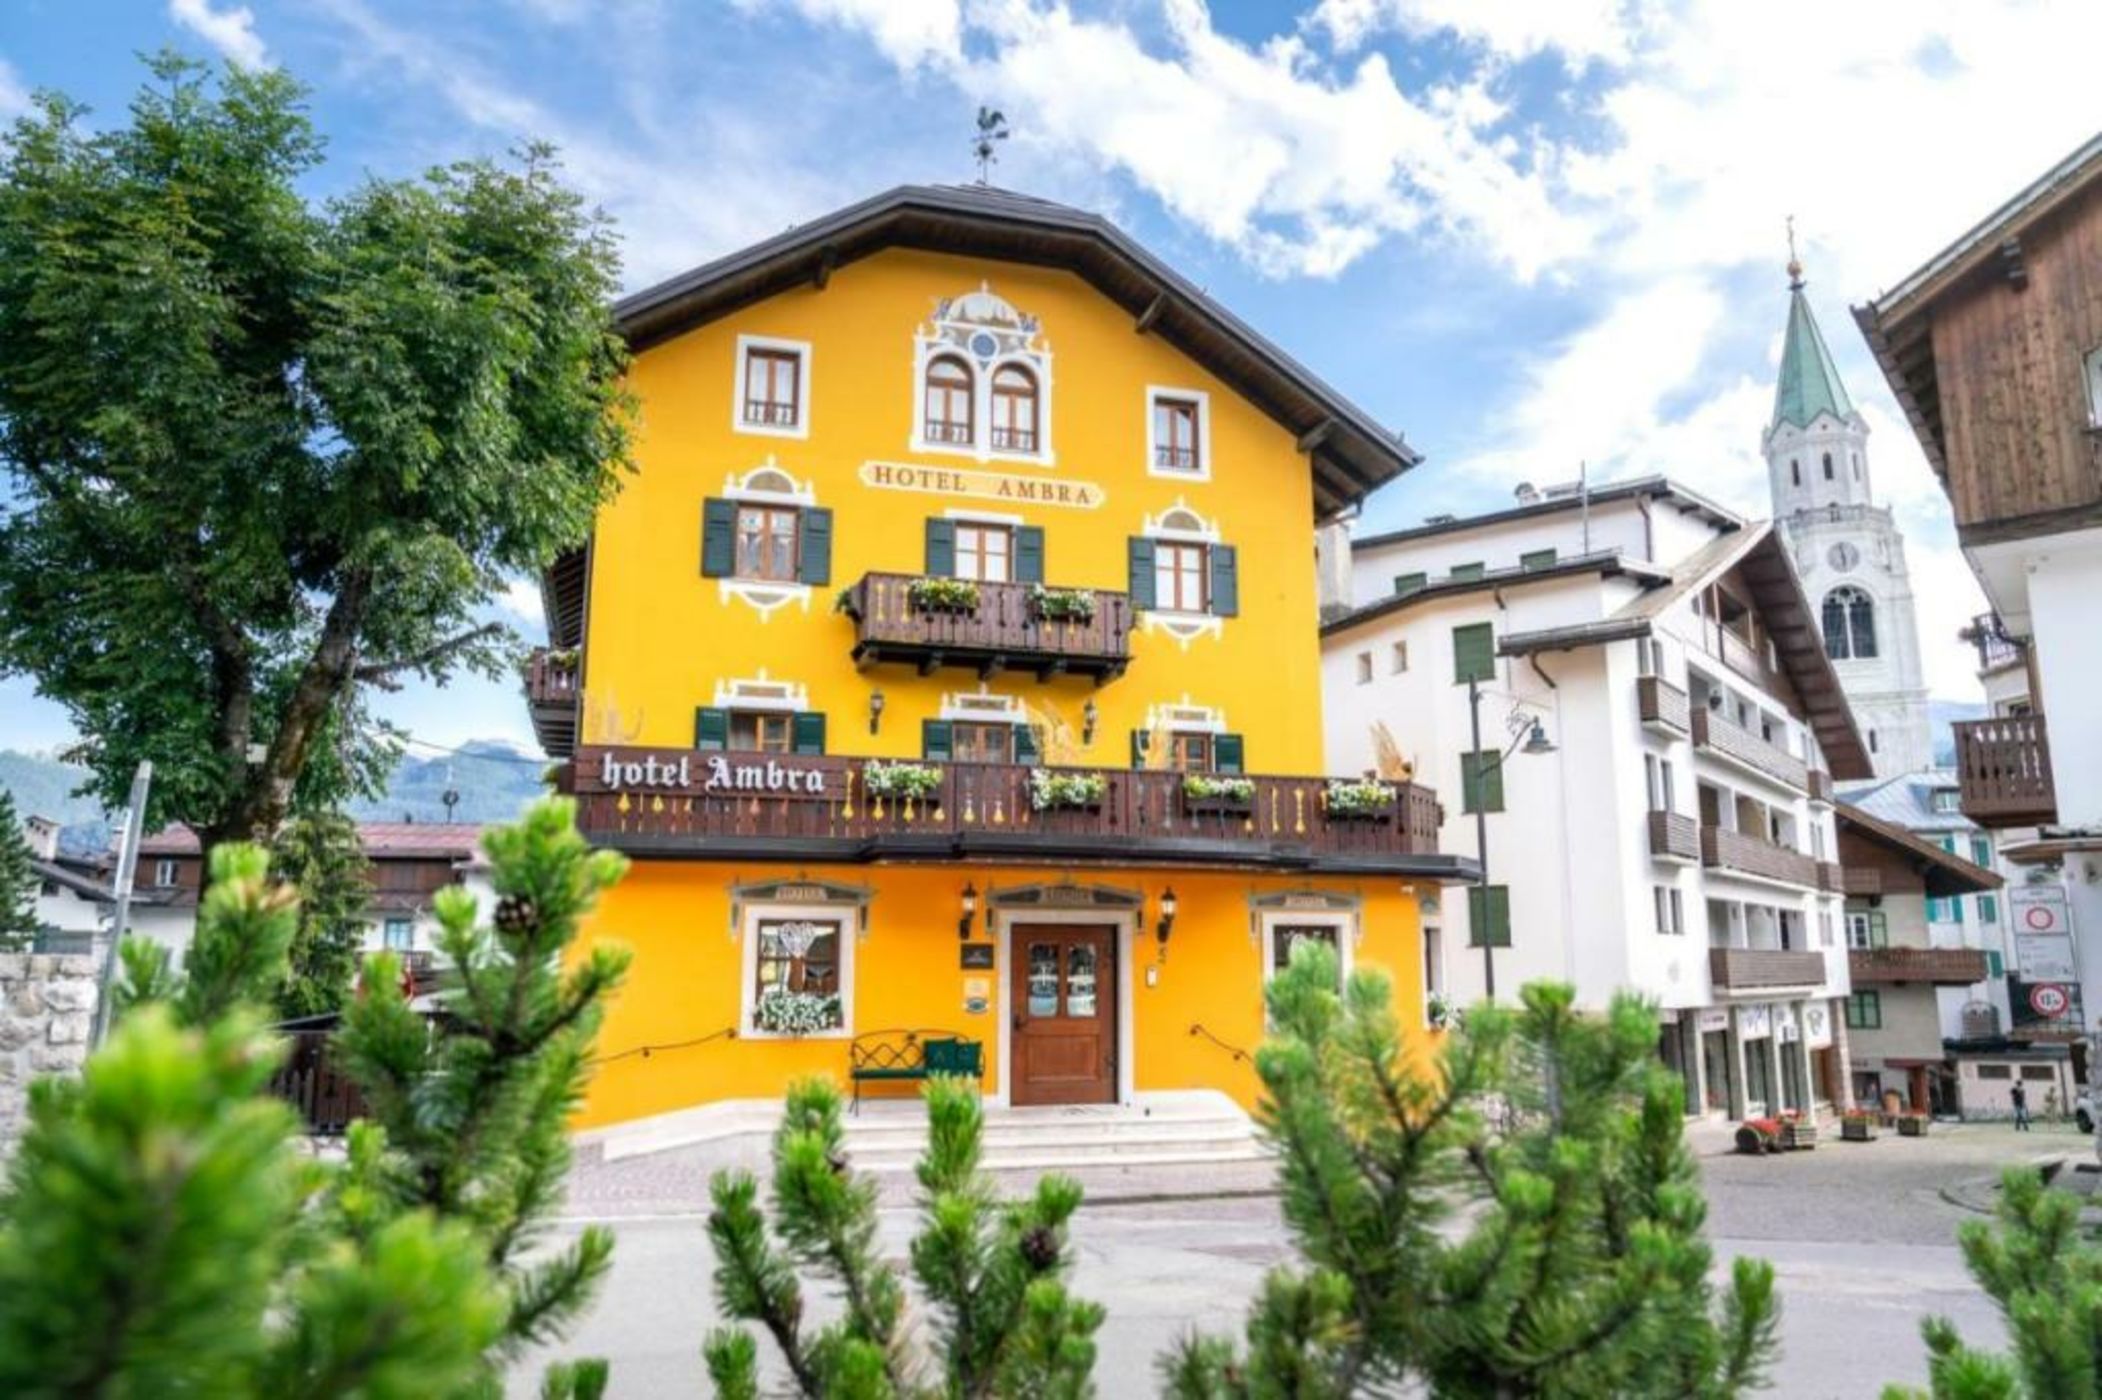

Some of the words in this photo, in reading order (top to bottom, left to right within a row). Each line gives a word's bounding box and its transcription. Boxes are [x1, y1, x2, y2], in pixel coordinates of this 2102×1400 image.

[874, 465, 967, 492] HOTEL
[997, 479, 1091, 504] AMBRA
[602, 752, 690, 790] hotel
[705, 756, 825, 793] Ambra
